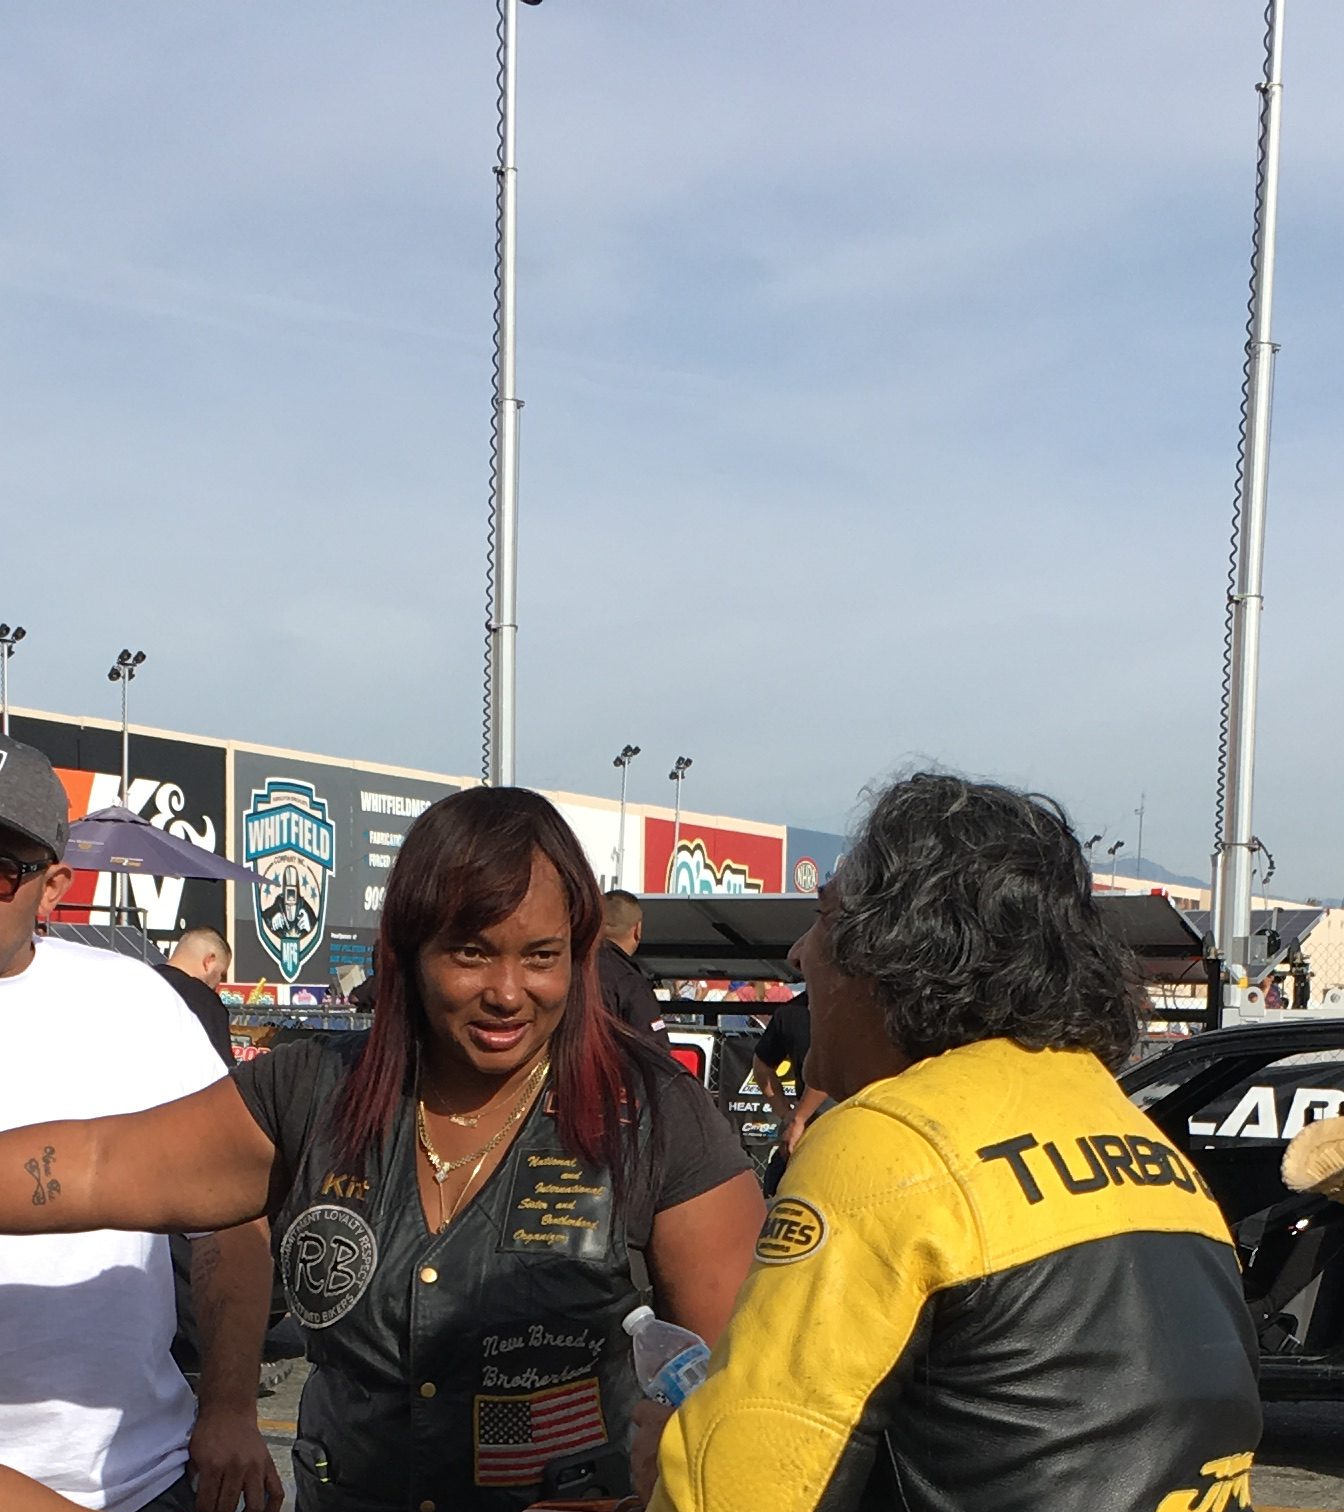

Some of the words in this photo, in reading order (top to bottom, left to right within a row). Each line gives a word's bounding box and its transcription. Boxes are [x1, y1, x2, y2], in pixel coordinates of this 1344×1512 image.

[248, 810, 331, 861] WHITFIELD
[281, 941, 299, 972] MFG
[728, 1102, 761, 1113] HEAT
[762, 1103, 773, 1113] &
[527, 1155, 577, 1168] National
[560, 1170, 582, 1180] and
[975, 1132, 1197, 1206] TURBO
[534, 1181, 607, 1195] International
[555, 1199, 577, 1209] and
[540, 1213, 600, 1230] Brotherhood
[324, 1210, 365, 1235] LOYALTY
[356, 1233, 373, 1288] RESPECT
[322, 1293, 354, 1322] BIKERS
[482, 1335, 525, 1357] New
[527, 1324, 589, 1348] Breed
[588, 1337, 605, 1357] of
[482, 1357, 600, 1389] Brotherhood
